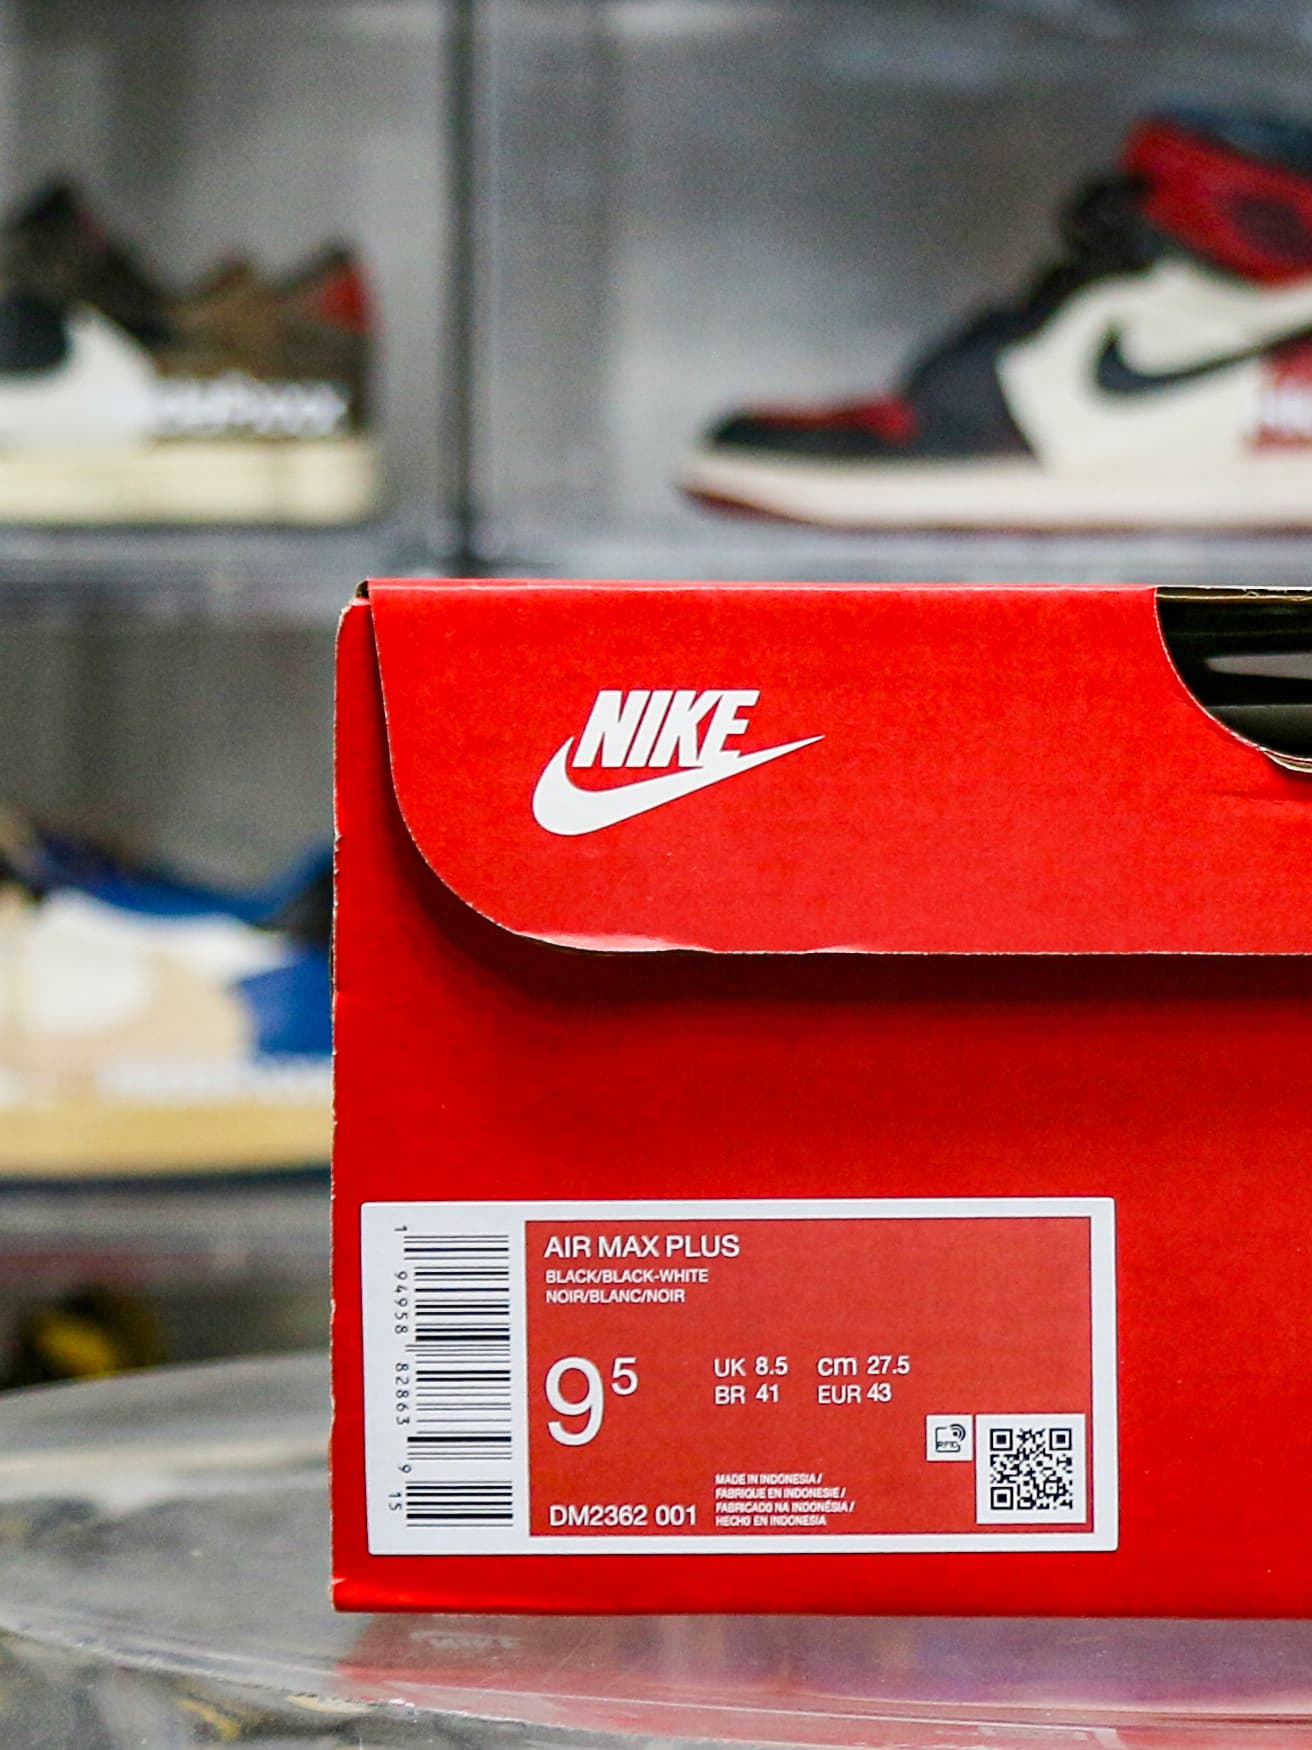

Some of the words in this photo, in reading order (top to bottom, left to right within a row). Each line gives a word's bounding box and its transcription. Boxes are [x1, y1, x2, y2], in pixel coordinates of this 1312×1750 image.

[571, 689, 761, 768] NIKE
[544, 1235, 592, 1258] AIR
[598, 1235, 660, 1258] MAX
[666, 1234, 741, 1258] PLUS
[546, 1269, 709, 1284] BLACK/BLACK-WHITE
[394, 1270, 408, 1334] 94958
[546, 1289, 686, 1304] NOIR/BLANC/NOIR
[714, 1358, 746, 1377] UK
[755, 1356, 789, 1376] 8.5
[817, 1357, 858, 1376] cm
[867, 1355, 911, 1375] 27.5
[395, 1362, 410, 1425] 82863
[715, 1385, 746, 1404] BR
[756, 1384, 780, 1403] 41
[818, 1385, 862, 1404] EUR
[867, 1382, 893, 1402] 43
[398, 1464, 412, 1474] 9
[715, 1473, 746, 1485] MADE
[747, 1473, 759, 1485] IN
[759, 1473, 816, 1485] INDONESIA
[388, 1492, 402, 1511] 15
[715, 1487, 766, 1499] FABRIQUE
[767, 1487, 783, 1499] EN
[550, 1504, 648, 1527] DM2362
[655, 1504, 696, 1526] 001
[715, 1502, 773, 1513] FABRICADO
[774, 1502, 790, 1513] NA
[715, 1515, 751, 1527] HECHO
[753, 1515, 768, 1526] EN
[770, 1515, 827, 1526] INDONESIA
